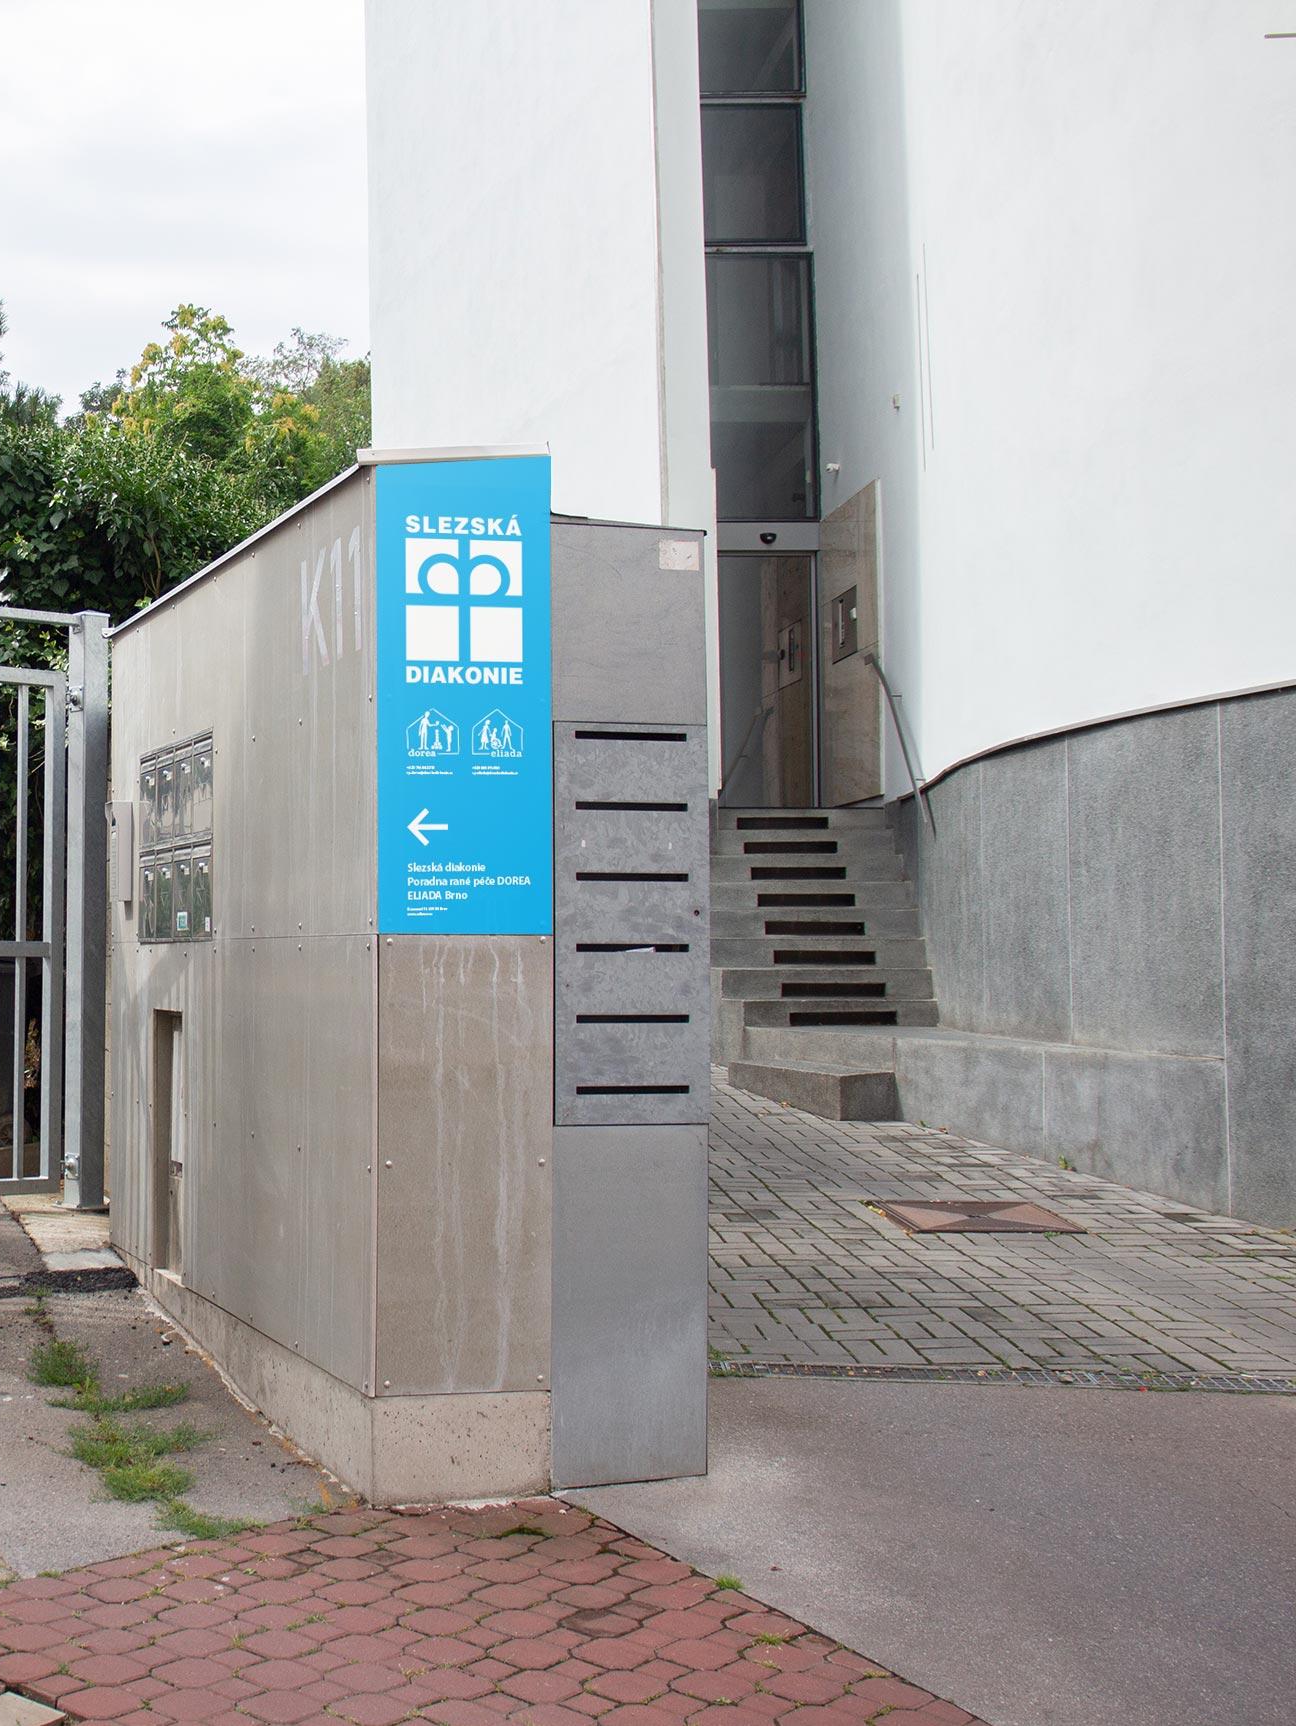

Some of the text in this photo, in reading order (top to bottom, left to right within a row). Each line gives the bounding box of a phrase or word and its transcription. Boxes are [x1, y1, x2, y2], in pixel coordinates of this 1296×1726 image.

[406, 514, 522, 536] SLEZSKÁ
[406, 666, 523, 685] DIAKONIE
[408, 749, 436, 757] dorea
[491, 749, 523, 757] eliada
[407, 862, 486, 872] Slezská diakonie
[407, 876, 531, 887] Poradna rané péče DOREA
[407, 891, 468, 900] ELIADA Brno
